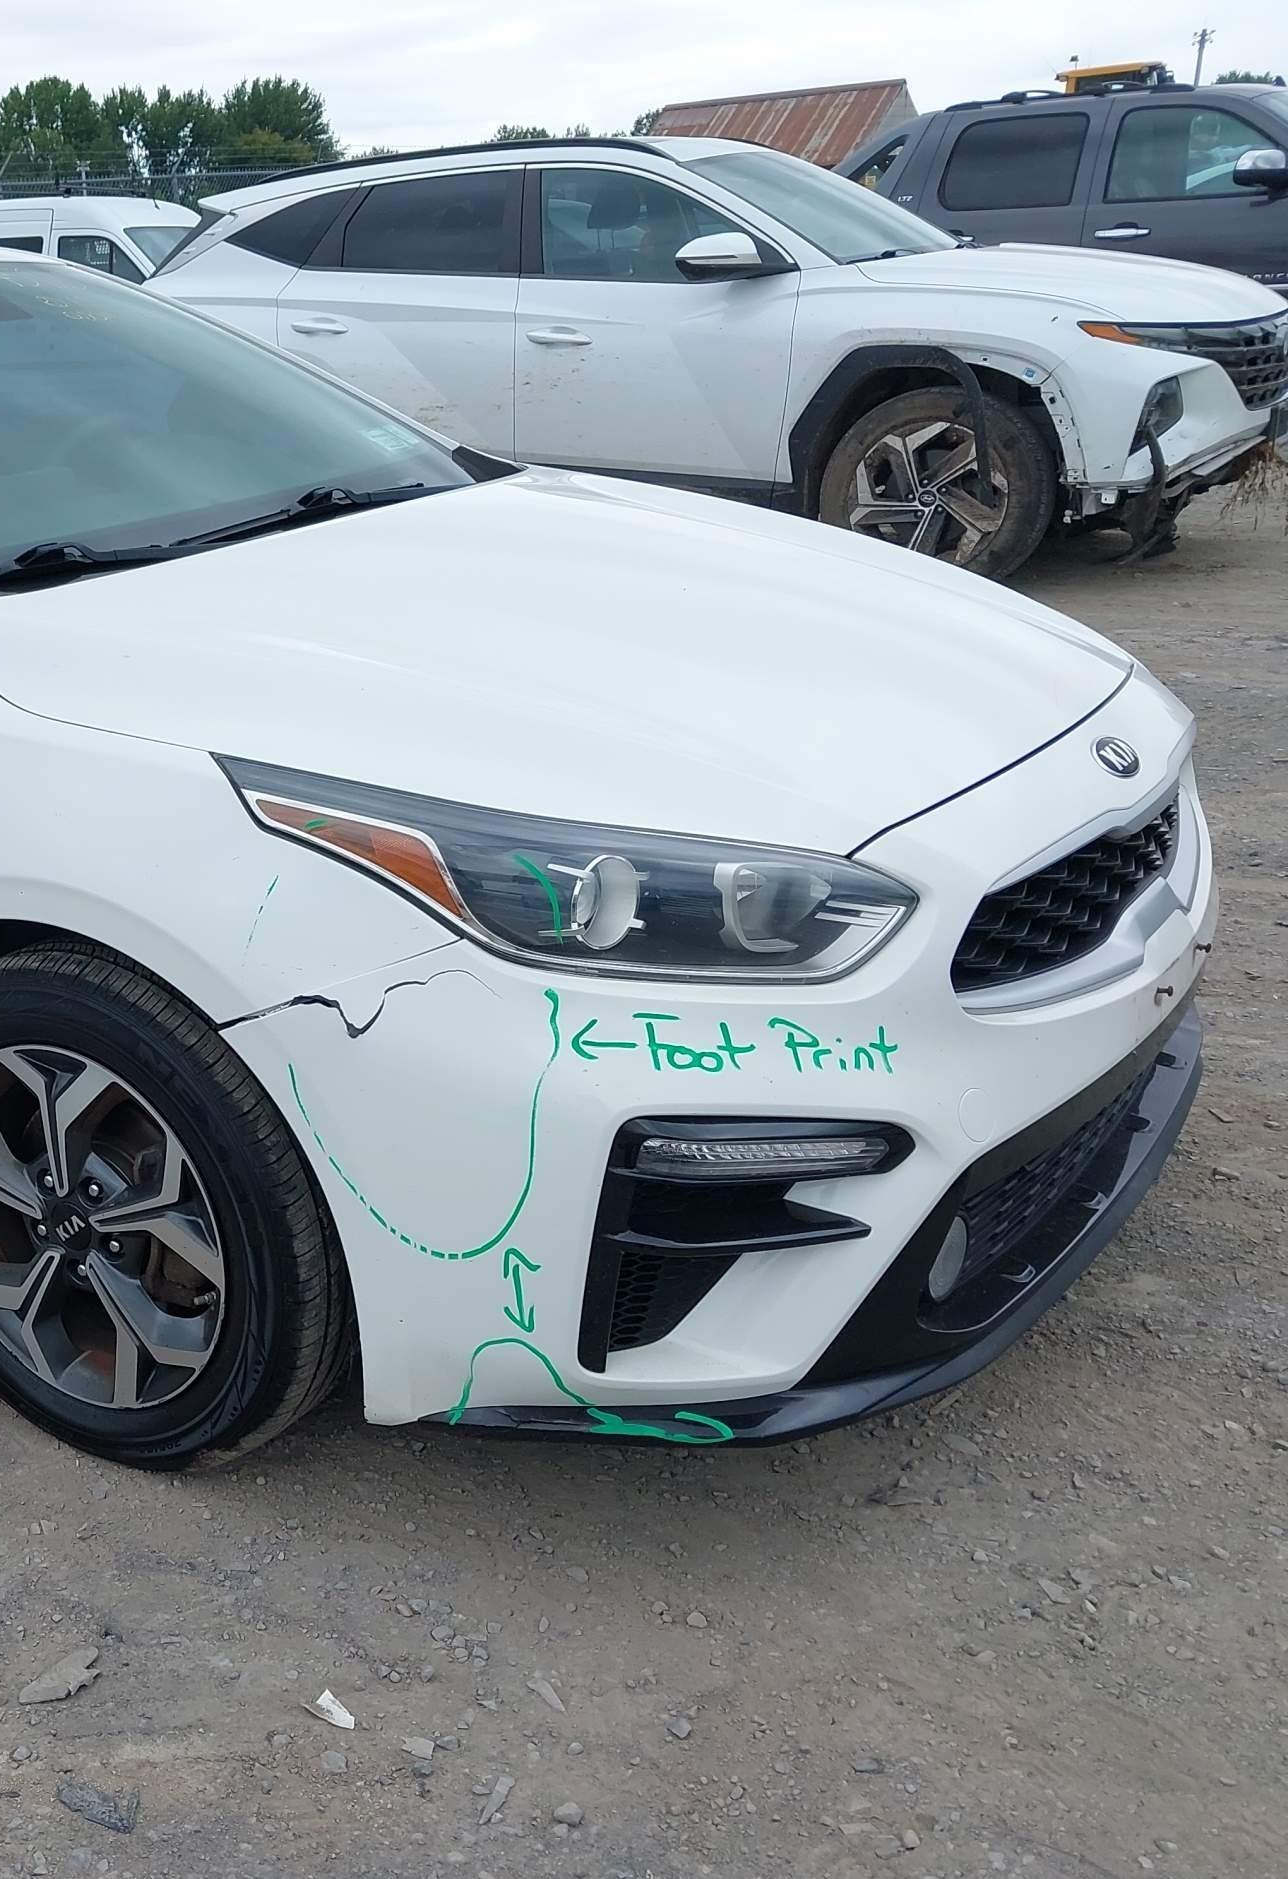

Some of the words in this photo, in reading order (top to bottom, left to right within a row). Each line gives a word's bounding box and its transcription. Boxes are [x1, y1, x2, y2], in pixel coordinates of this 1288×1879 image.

[1098, 739, 1136, 772] KIA
[767, 1017, 899, 1074] Print
[55, 1215, 86, 1242] KIA
